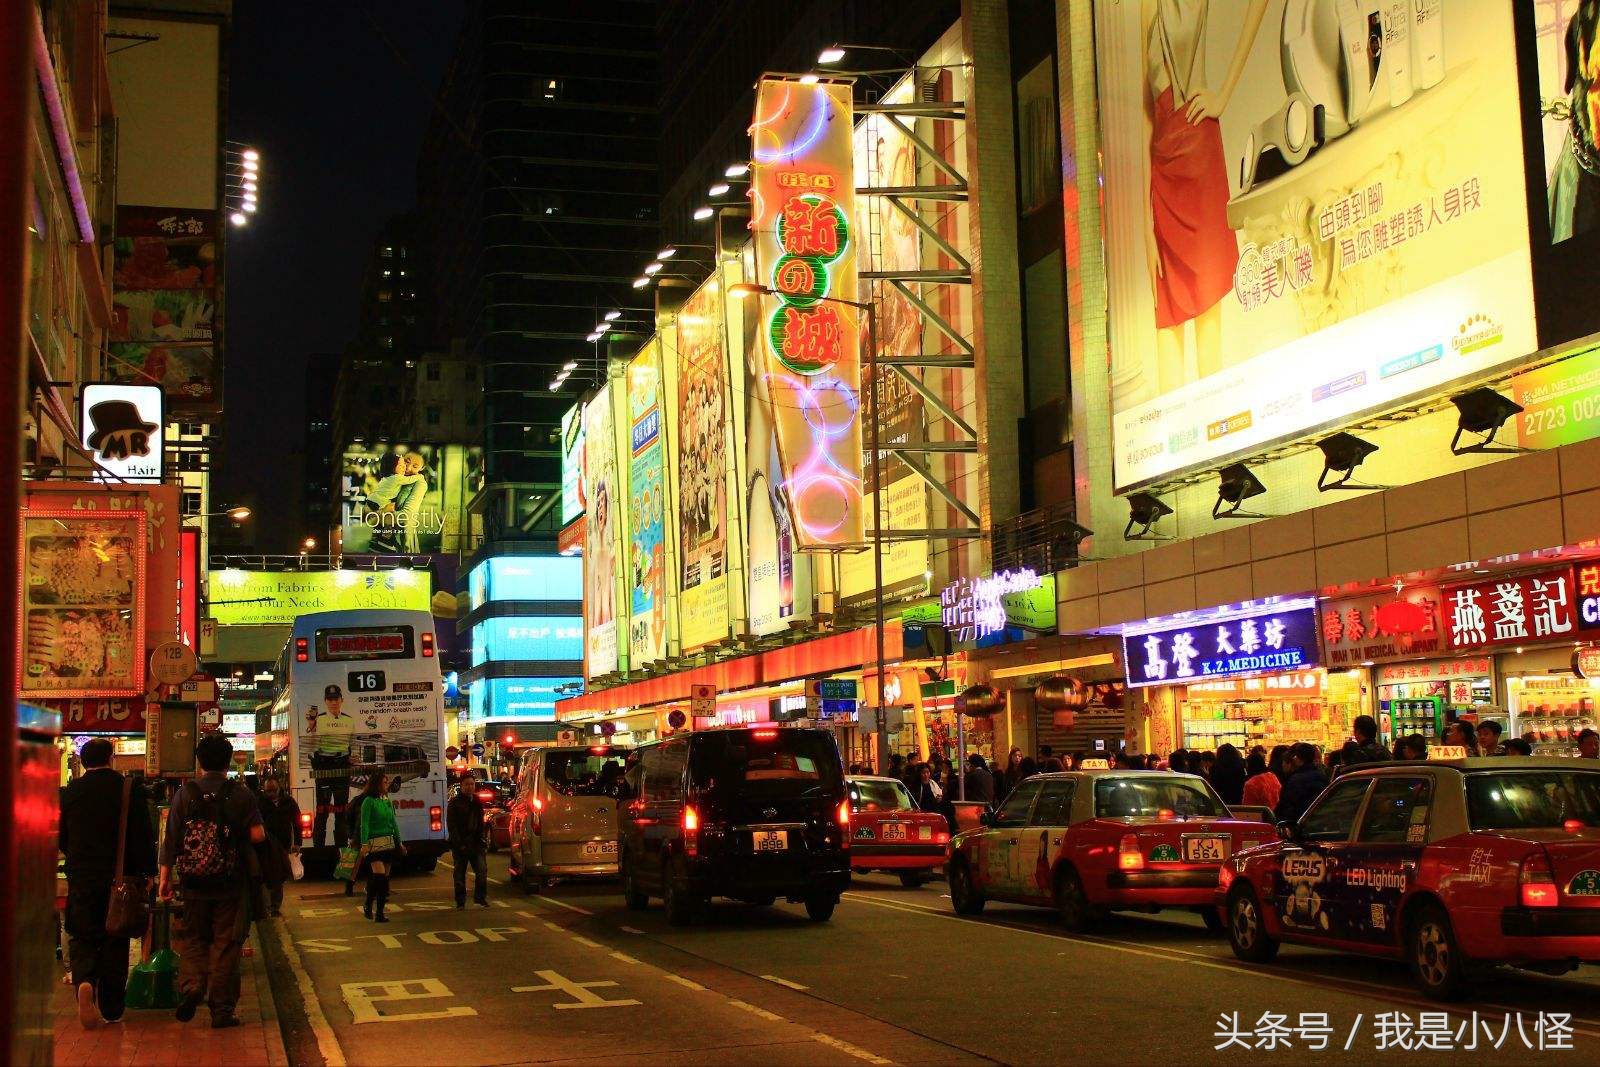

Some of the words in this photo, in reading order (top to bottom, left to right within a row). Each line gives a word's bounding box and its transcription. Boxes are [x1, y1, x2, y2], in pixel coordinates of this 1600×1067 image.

[1320, 182, 1384, 239] 由頭到腳
[1340, 177, 1481, 268] 為您雕塑誘人身段
[1261, 245, 1314, 304] 美人機
[1524, 404, 1566, 436] 2723
[102, 432, 150, 459] MR
[127, 465, 156, 475] Hair
[347, 506, 447, 534] Honestly
[277, 582, 325, 593] Fabrics
[254, 597, 285, 608] Your
[288, 597, 325, 608] Needs
[1449, 577, 1572, 646] 燕盞記
[202, 623, 212, 637] 行
[164, 647, 182, 660] 12B
[1143, 632, 1199, 680] 高登
[1331, 650, 1348, 663] WAH
[1350, 648, 1361, 661] TAI
[1364, 644, 1398, 660] MEDICAL
[1400, 639, 1438, 655] COMPANY
[357, 674, 377, 689] 16
[1435, 748, 1466, 757] TAXI
[1087, 760, 1107, 768] TAXI
[1193, 849, 1219, 859] 564
[1196, 840, 1214, 849] KJ
[1470, 848, 1494, 864] 的士
[1347, 868, 1366, 886] LED
[1367, 869, 1406, 893] Lighting
[1469, 864, 1491, 883] TAXI
[1588, 879, 1595, 888] 5
[294, 926, 528, 953] STOP
[341, 970, 643, 1025] 巴士
